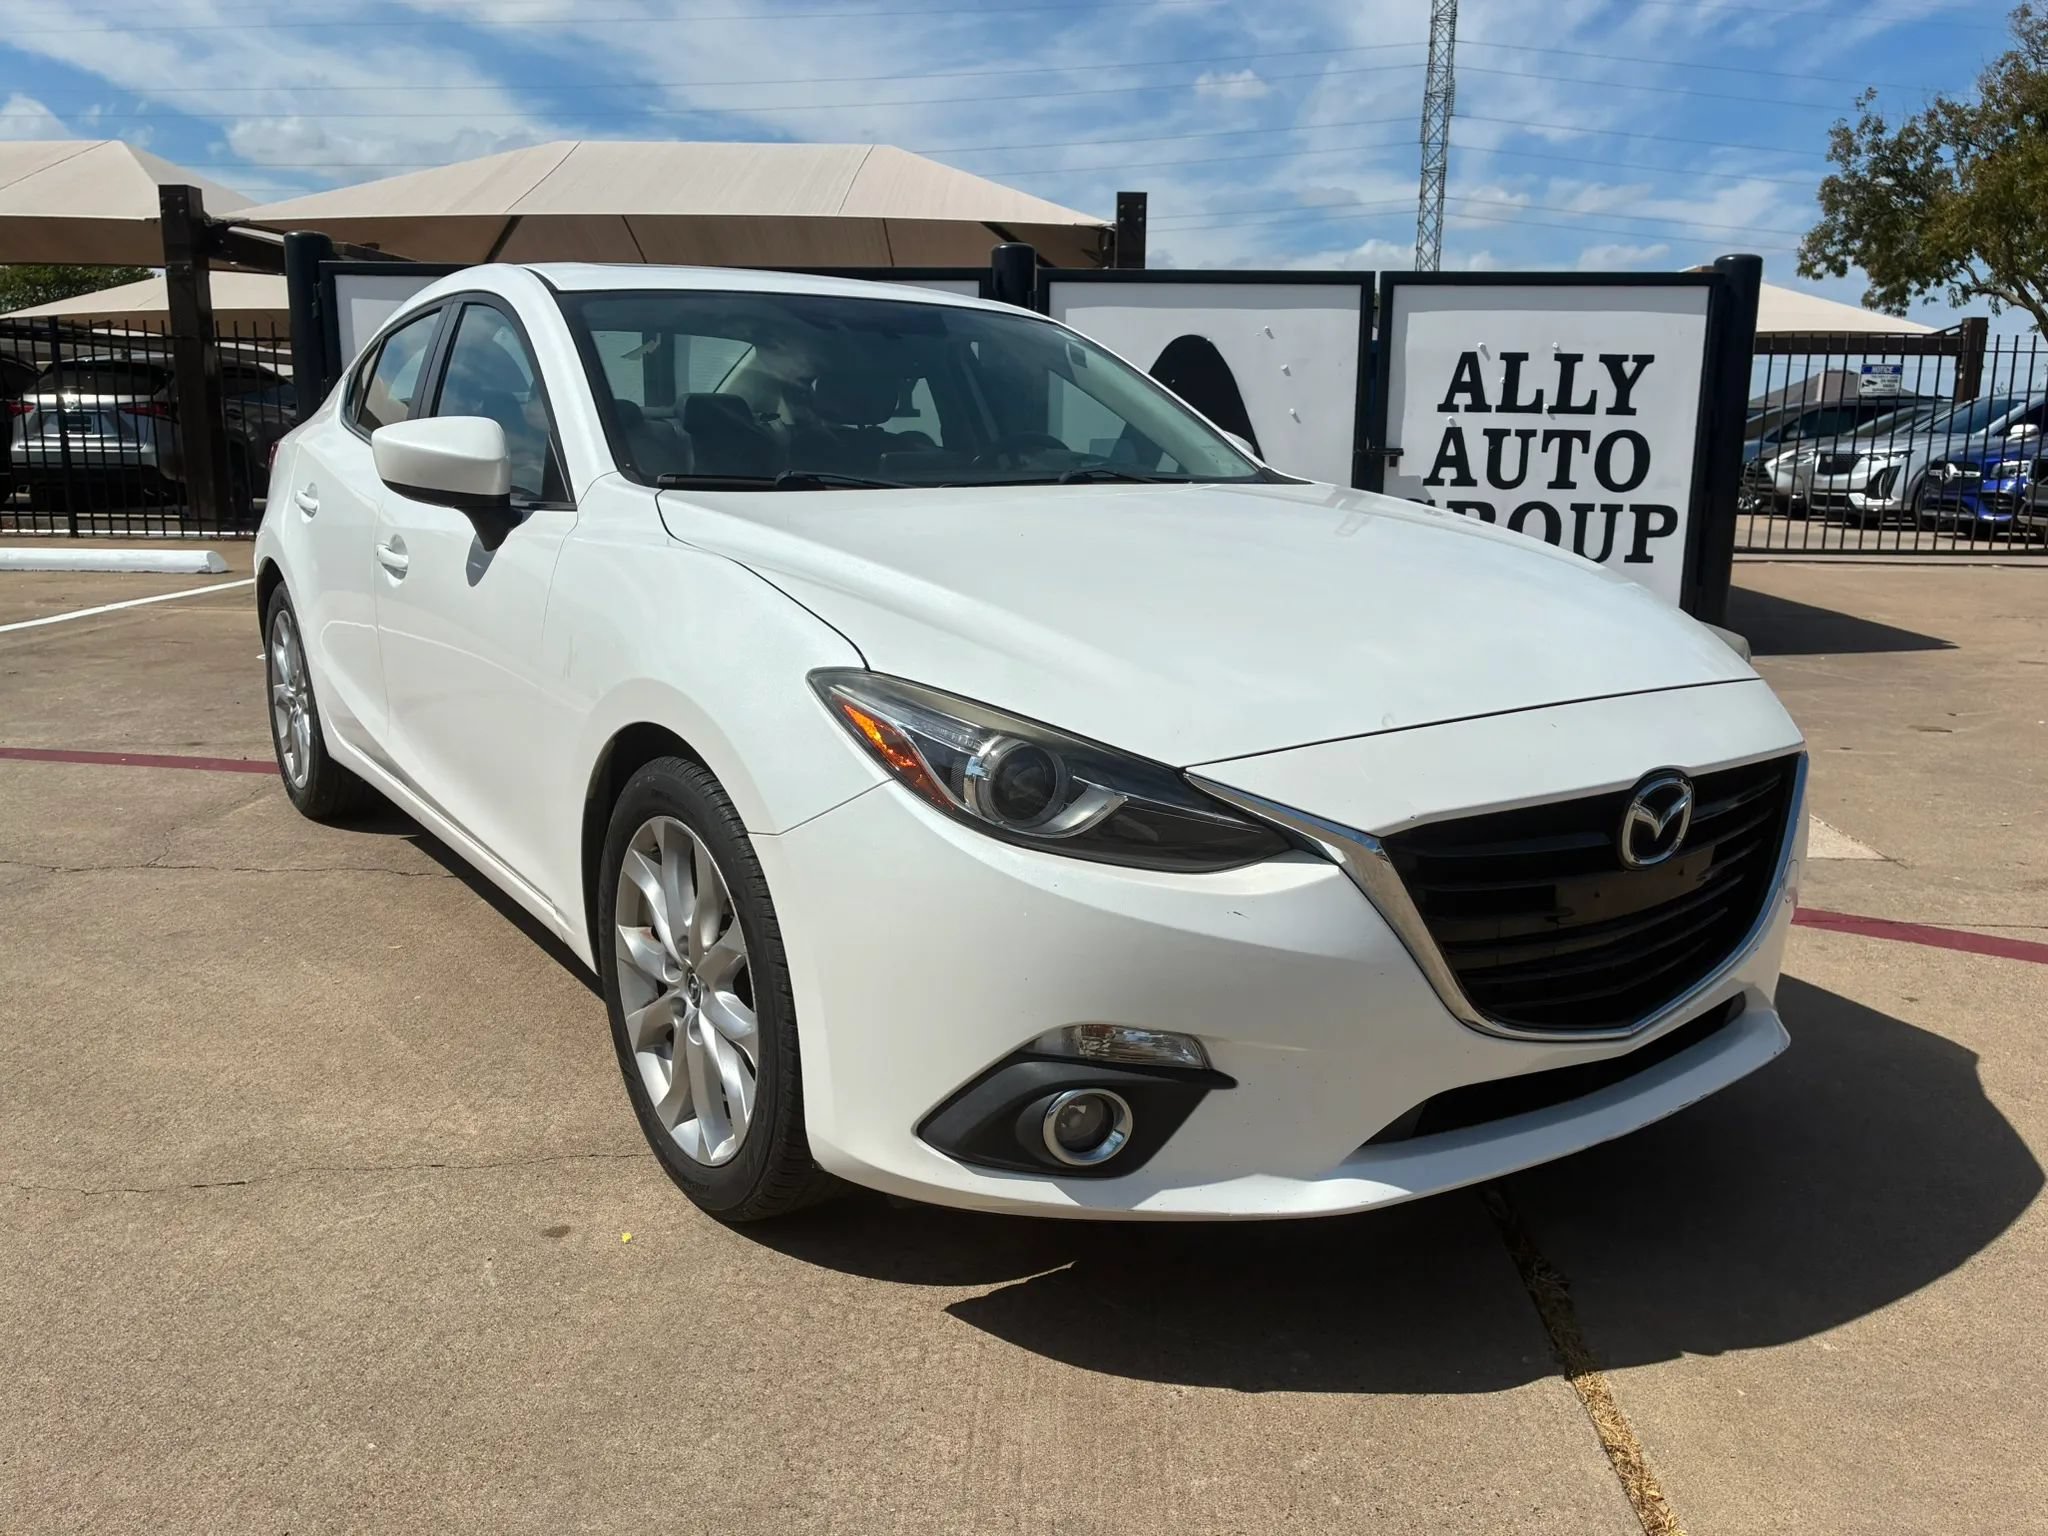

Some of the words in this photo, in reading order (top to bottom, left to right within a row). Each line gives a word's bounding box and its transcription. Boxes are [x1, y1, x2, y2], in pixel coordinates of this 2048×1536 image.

[1437, 351, 1655, 416] ALLY
[1422, 426, 1651, 493] AUTO
[1405, 498, 1678, 564] OUP
